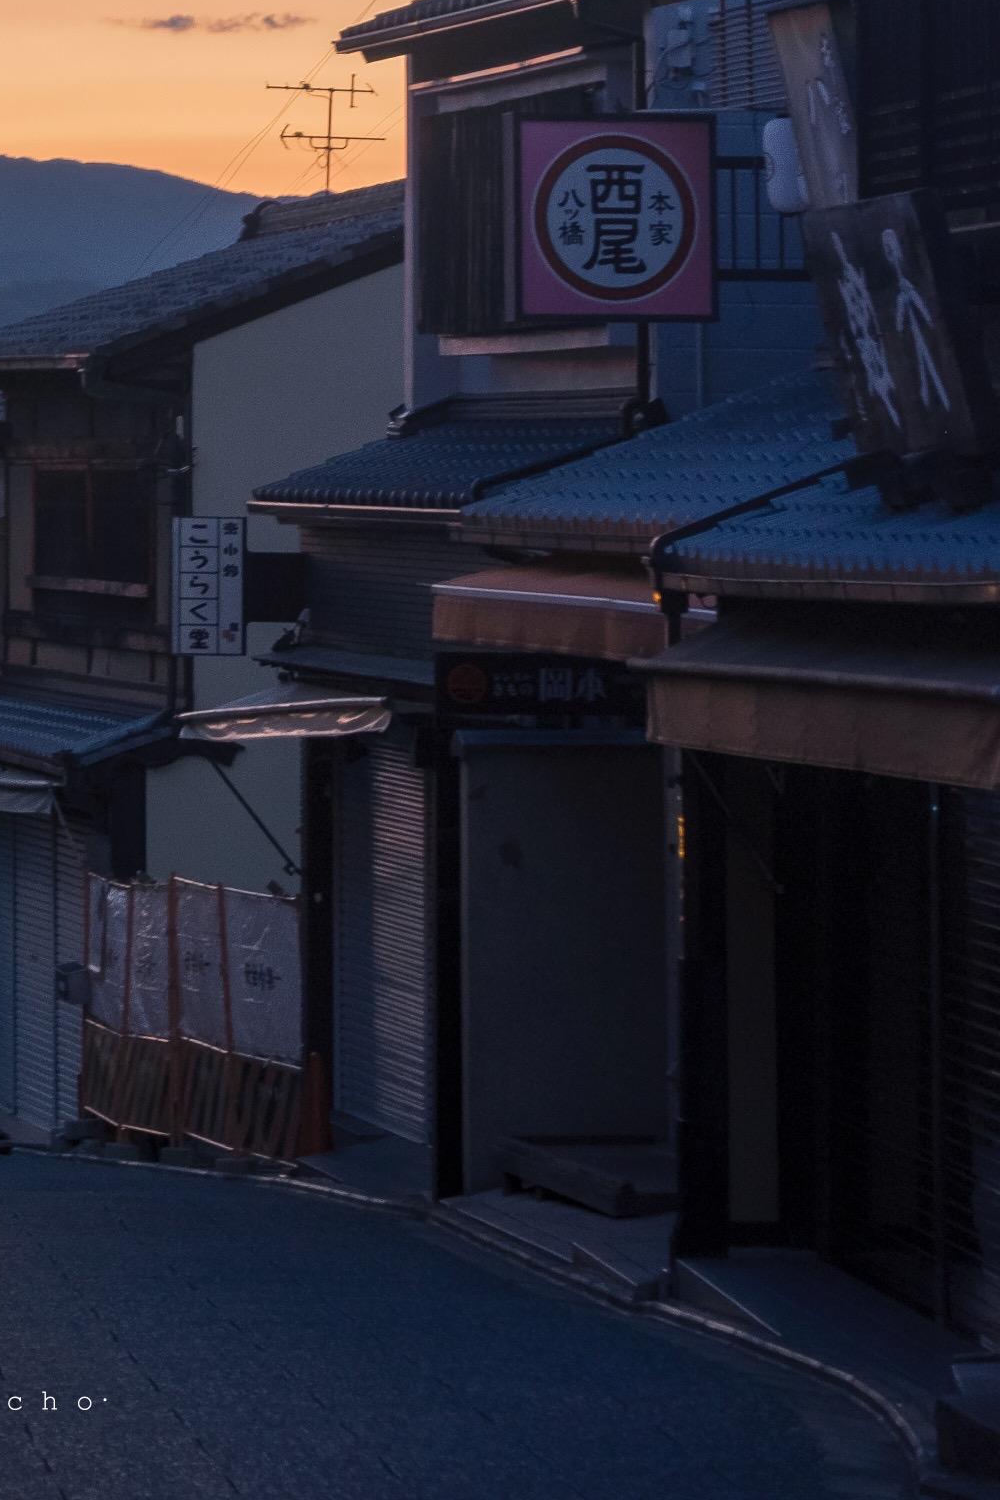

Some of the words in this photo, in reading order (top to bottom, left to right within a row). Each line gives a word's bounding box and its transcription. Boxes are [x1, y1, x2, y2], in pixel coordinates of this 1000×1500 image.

[582, 164, 647, 274] 西尾
[648, 191, 675, 246] 本家
[188, 523, 210, 650] こうらく堂
